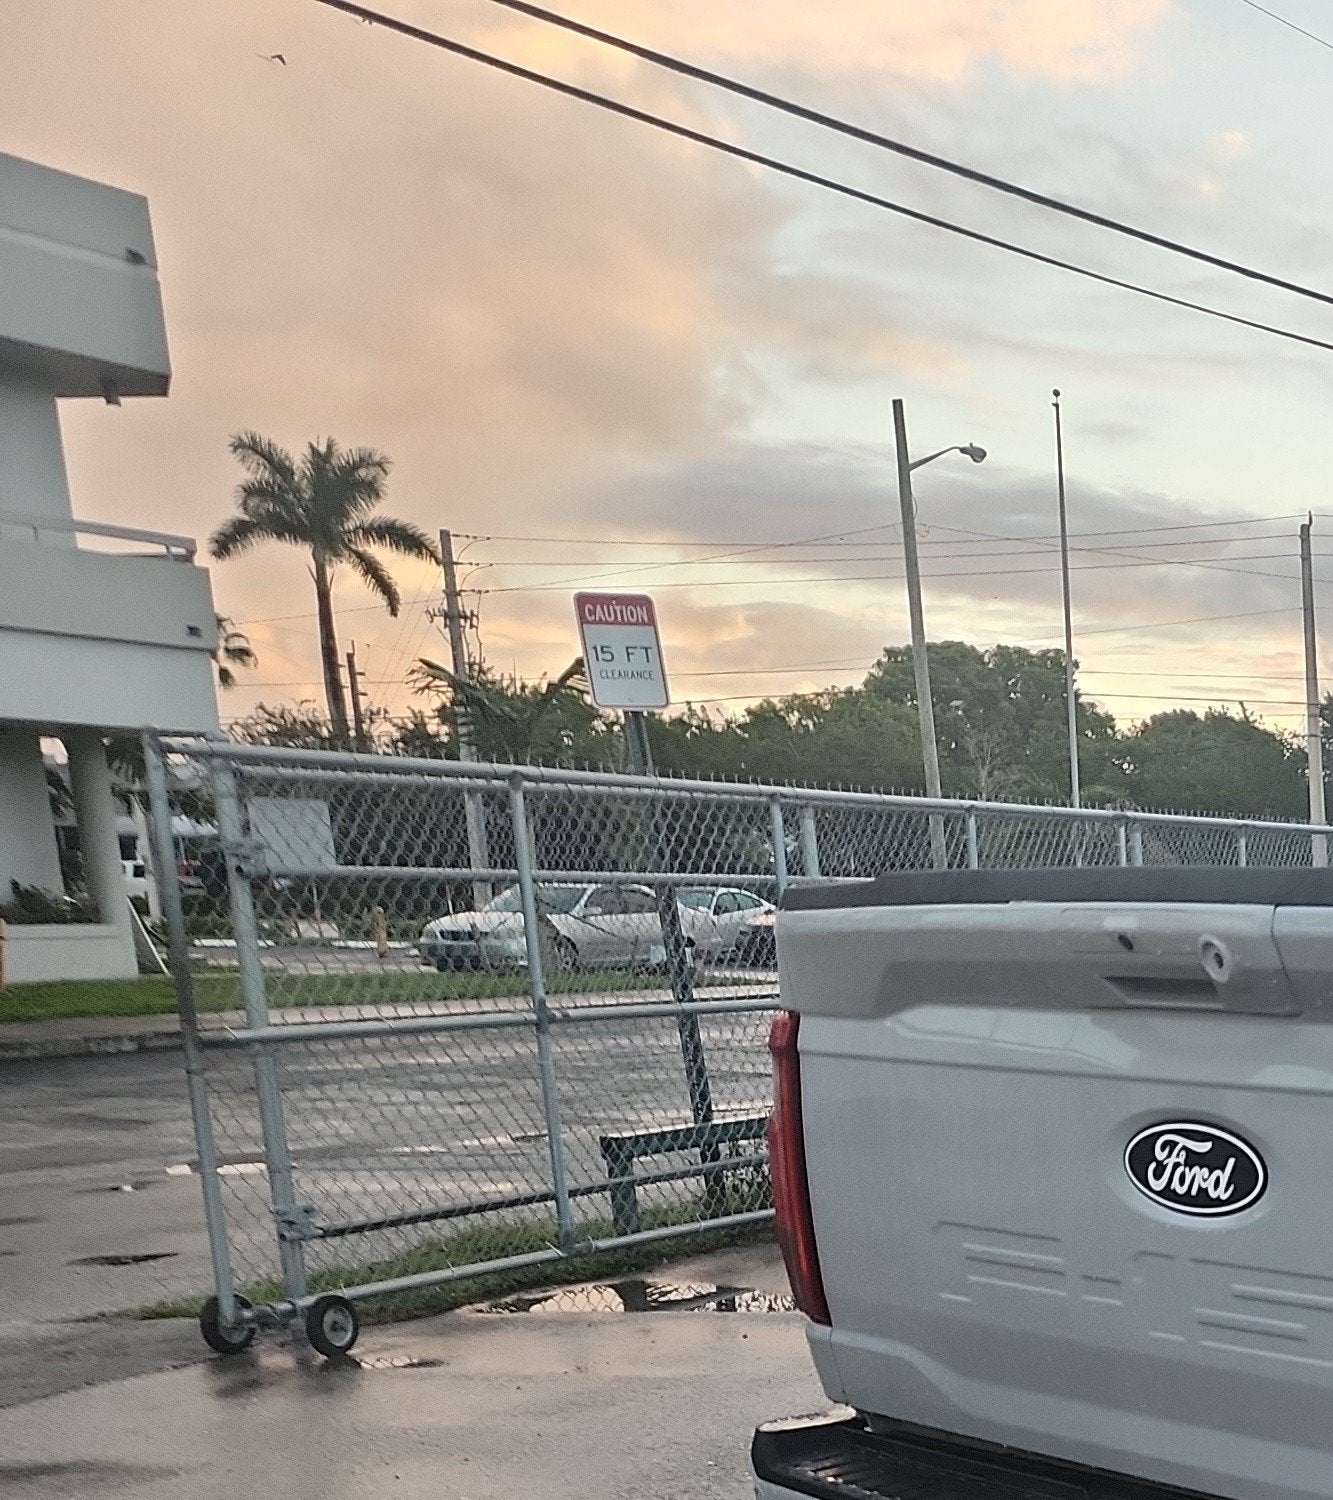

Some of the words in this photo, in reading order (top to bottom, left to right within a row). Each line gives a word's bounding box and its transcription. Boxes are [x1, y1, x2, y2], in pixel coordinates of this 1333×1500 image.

[584, 602, 649, 623] CAUTION
[591, 644, 615, 663] 15
[625, 645, 653, 663] FT
[599, 669, 655, 681] CLEARANCE
[1147, 1133, 1236, 1201] Ford
